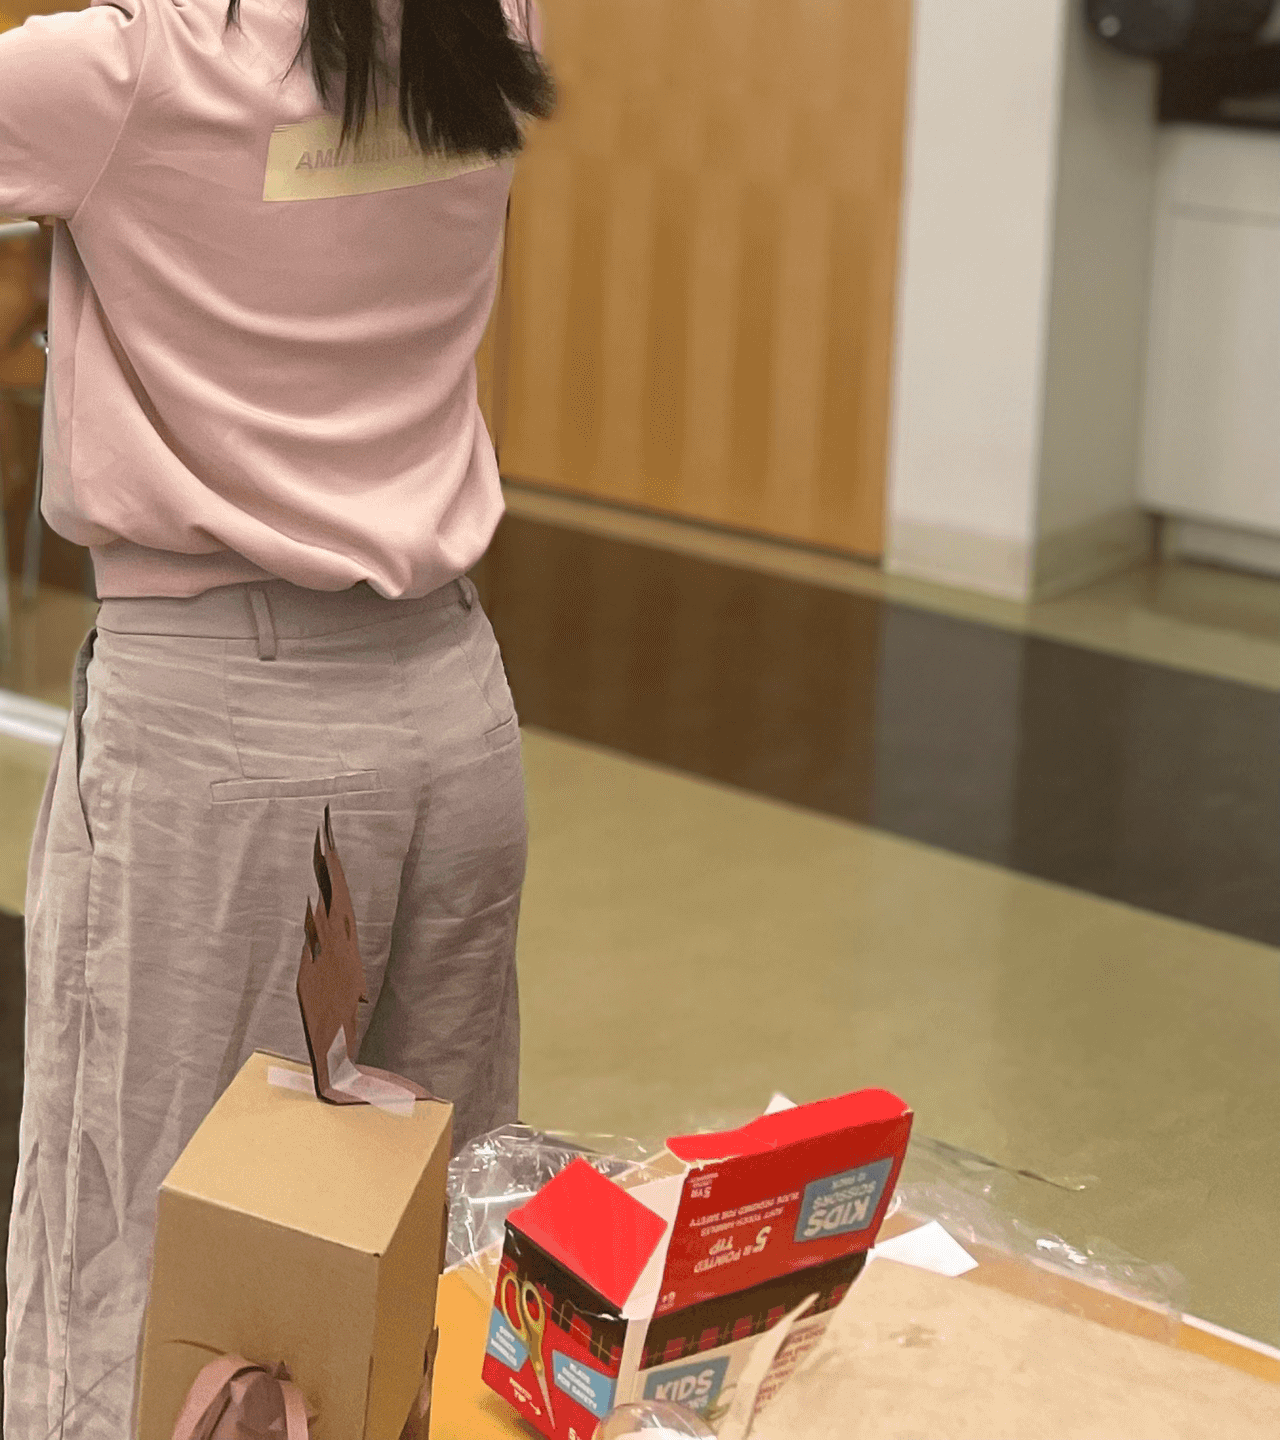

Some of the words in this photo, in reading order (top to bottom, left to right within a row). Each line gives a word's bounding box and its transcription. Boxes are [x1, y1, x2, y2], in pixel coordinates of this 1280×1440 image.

[803, 1195, 871, 1237] KIDS
[708, 1235, 734, 1257] TIP
[693, 1247, 742, 1274] POINTED
[571, 1384, 598, 1411] SAFETY
[654, 1368, 716, 1401] KIDS
